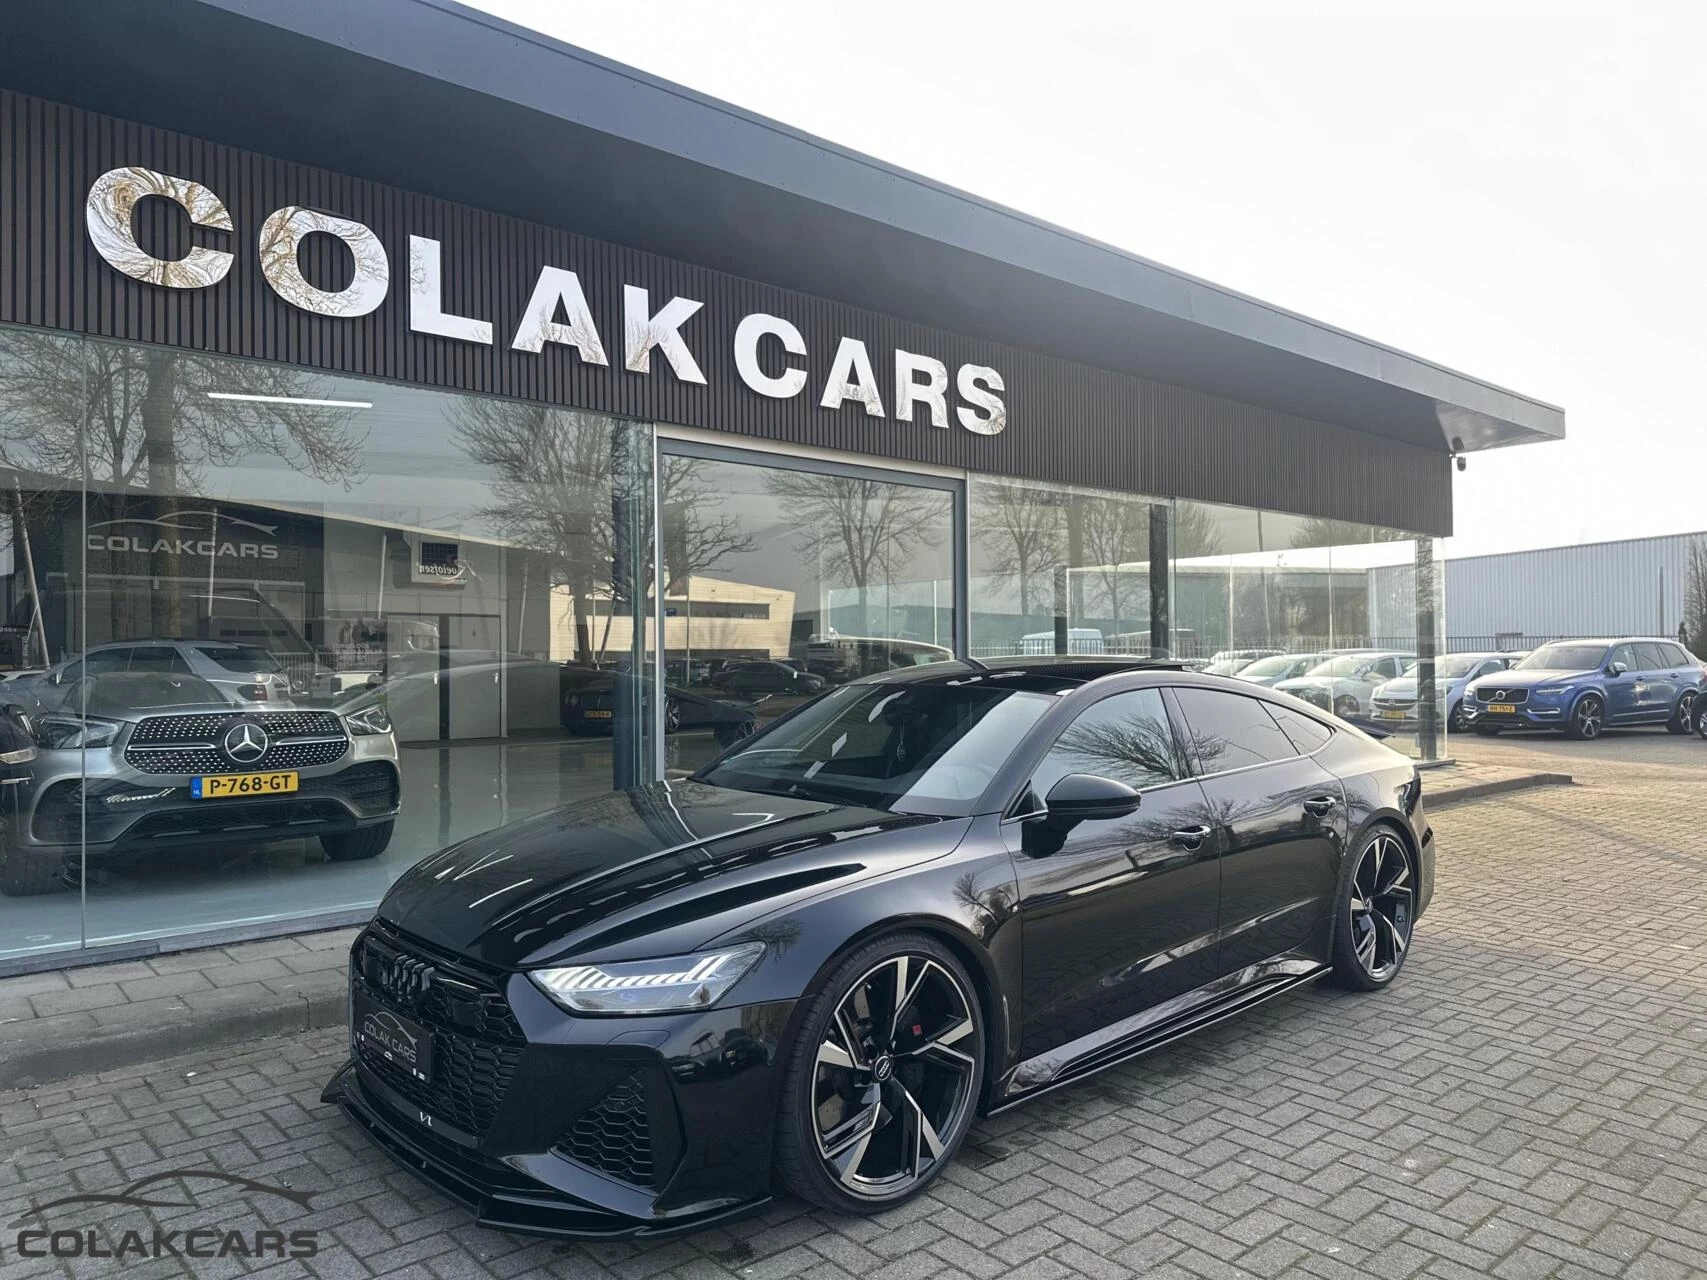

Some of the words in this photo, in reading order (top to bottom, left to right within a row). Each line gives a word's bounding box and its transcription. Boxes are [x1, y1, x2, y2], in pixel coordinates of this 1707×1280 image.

[86, 166, 708, 386] COLAK
[734, 312, 1008, 436] CARS
[87, 534, 280, 560] COLAKCARS
[210, 775, 292, 794] P-768-GT
[364, 1020, 391, 1047] COLAK
[392, 1038, 417, 1063] CARS
